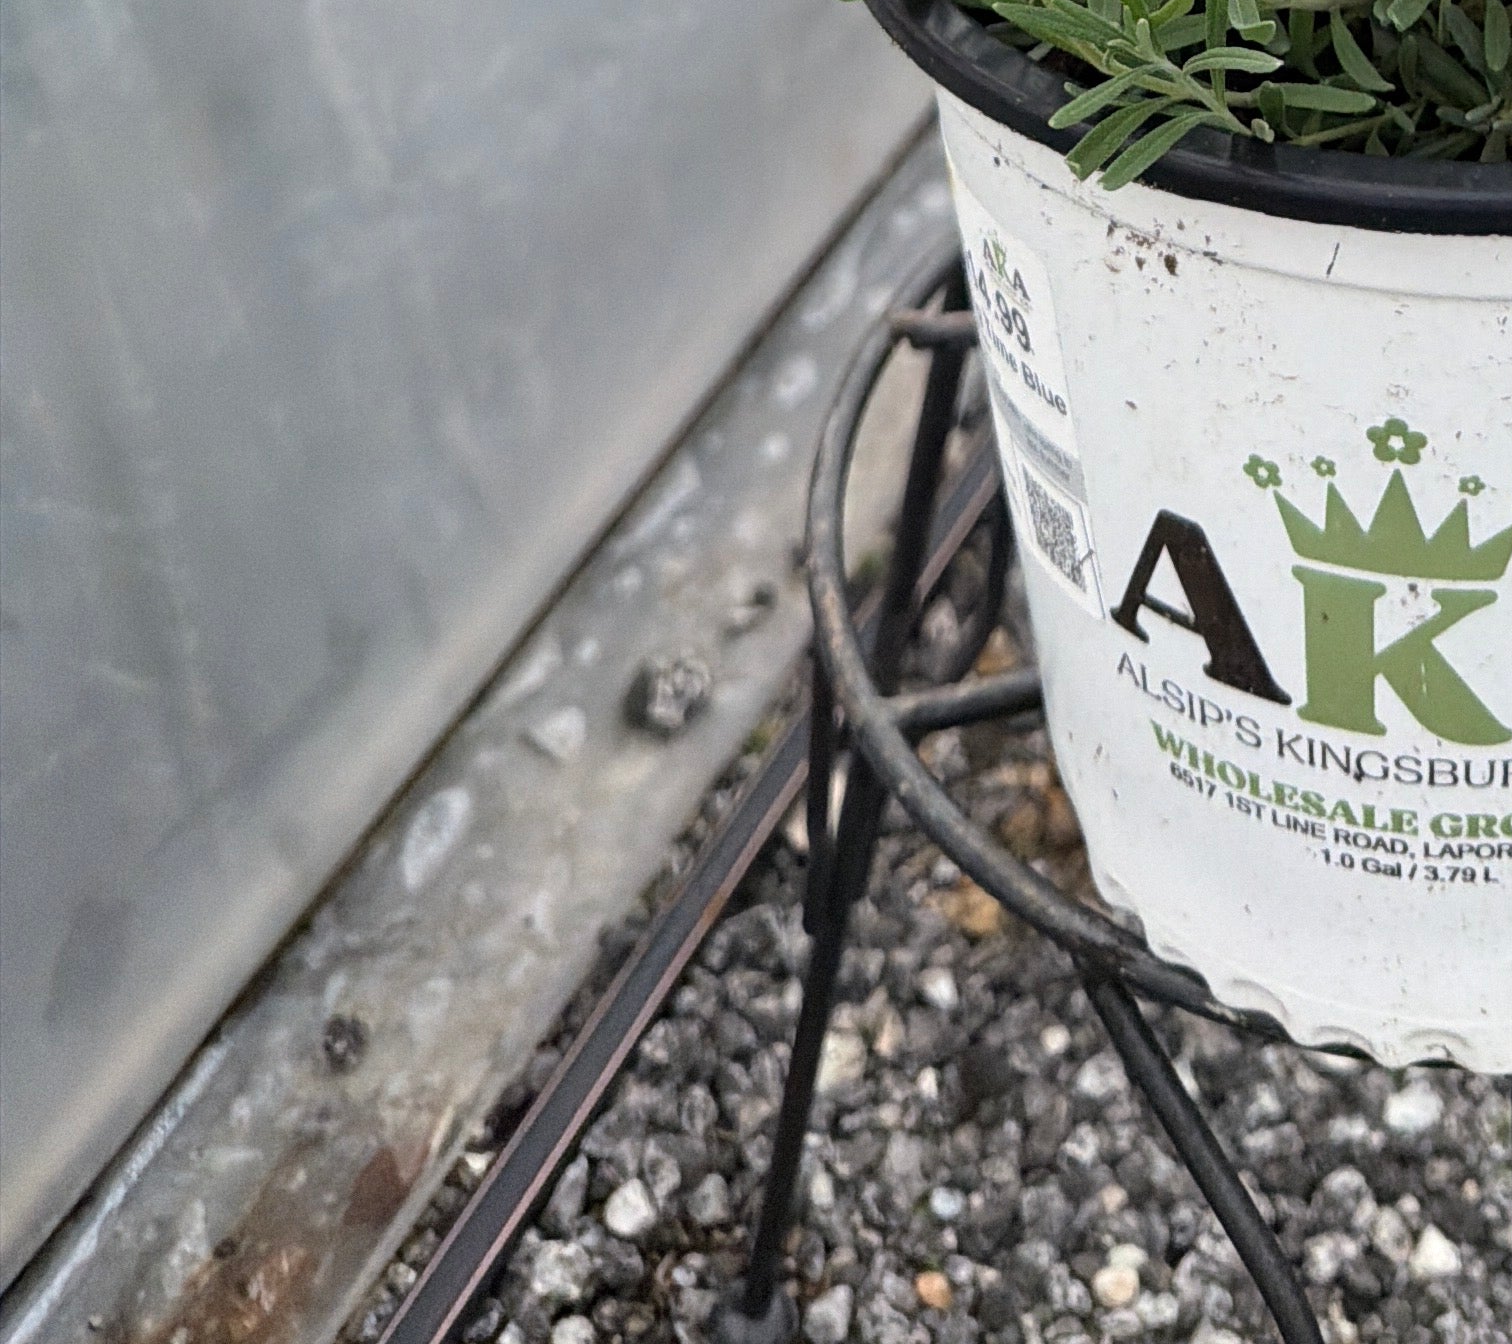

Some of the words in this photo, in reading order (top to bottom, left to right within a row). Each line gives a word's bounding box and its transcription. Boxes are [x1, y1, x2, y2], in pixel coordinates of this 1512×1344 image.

[1021, 360, 1068, 416] Blue
[1116, 651, 1263, 749] ALSIP'S
[1151, 718, 1420, 837] WHOLESALE
[1169, 761, 1218, 799] 6517
[1225, 791, 1267, 821] 1ST
[1271, 808, 1327, 841] LINE
[1333, 827, 1416, 860] ROAD,
[1321, 847, 1356, 870] 1.0
[1361, 857, 1402, 880] Gal
[1408, 863, 1418, 881] /
[1423, 864, 1477, 884] 3.79
[1483, 865, 1500, 884] L
